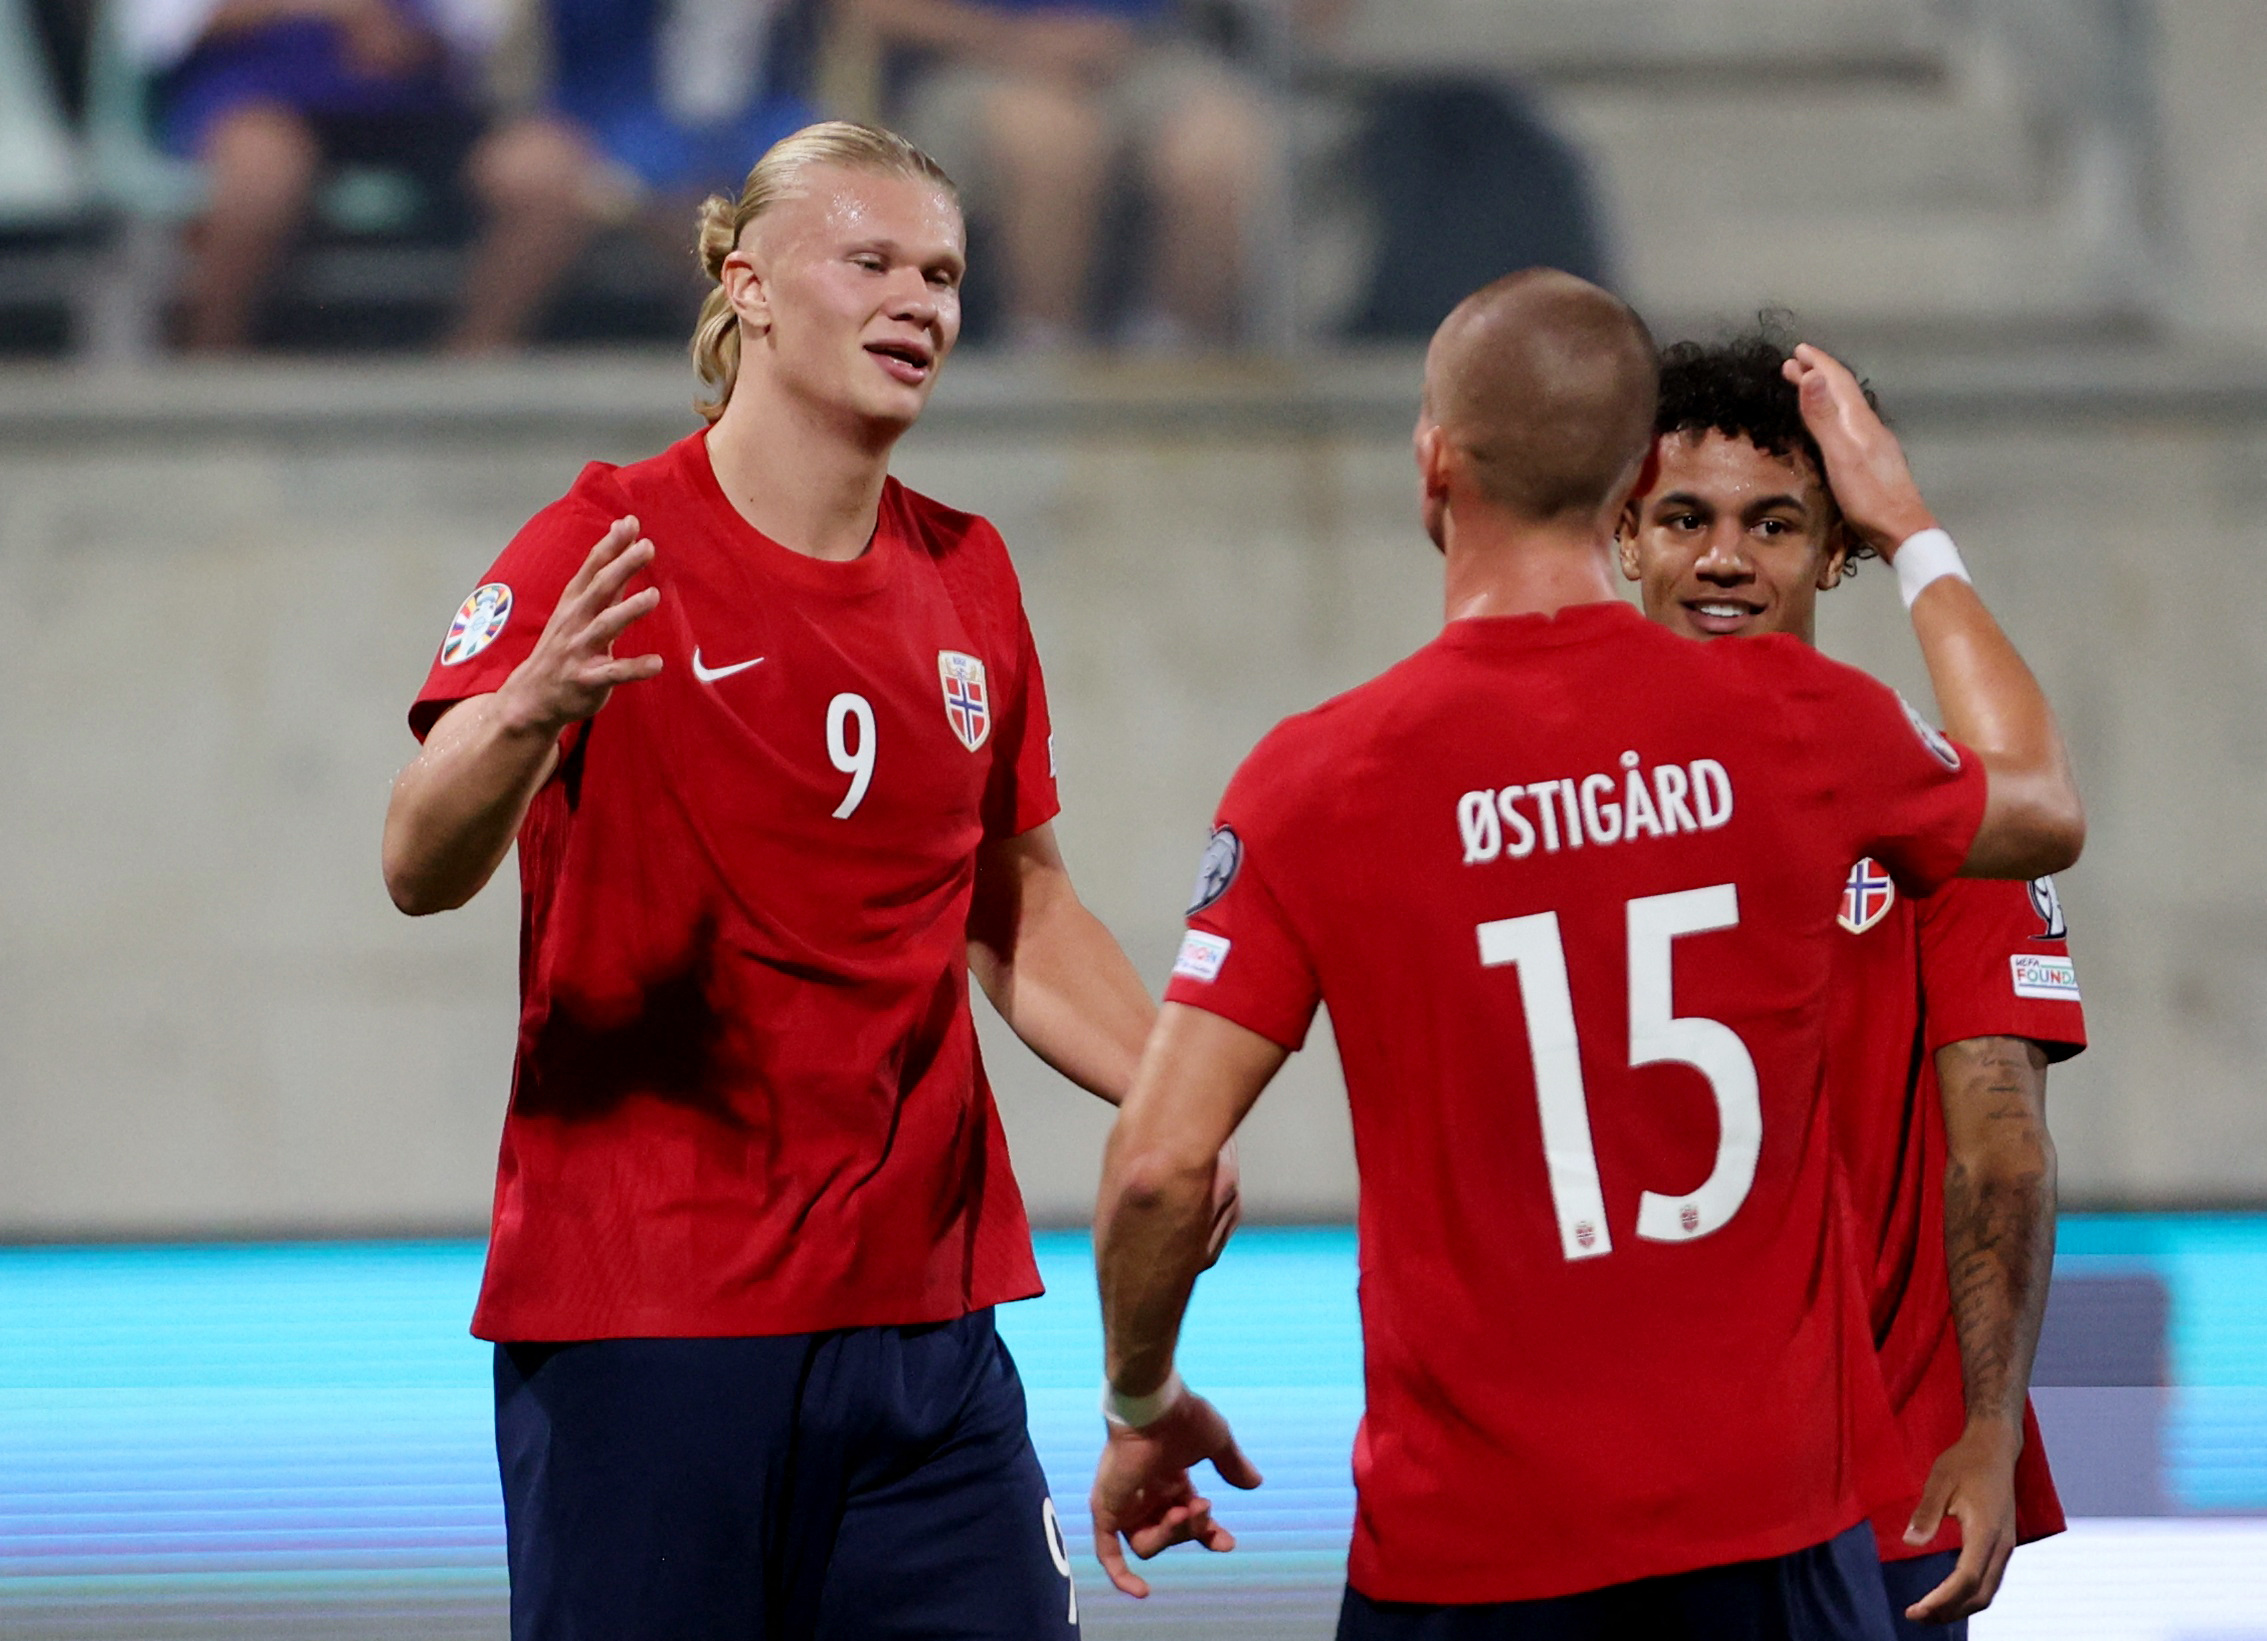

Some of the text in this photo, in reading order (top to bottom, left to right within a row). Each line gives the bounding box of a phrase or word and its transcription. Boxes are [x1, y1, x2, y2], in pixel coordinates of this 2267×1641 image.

[826, 692, 877, 819] 9
[1457, 751, 1734, 866] ØSTIGÅRD
[2014, 957, 2040, 967] UEFA
[2016, 968, 2076, 984] FOUND
[1476, 883, 1763, 1261] 15
